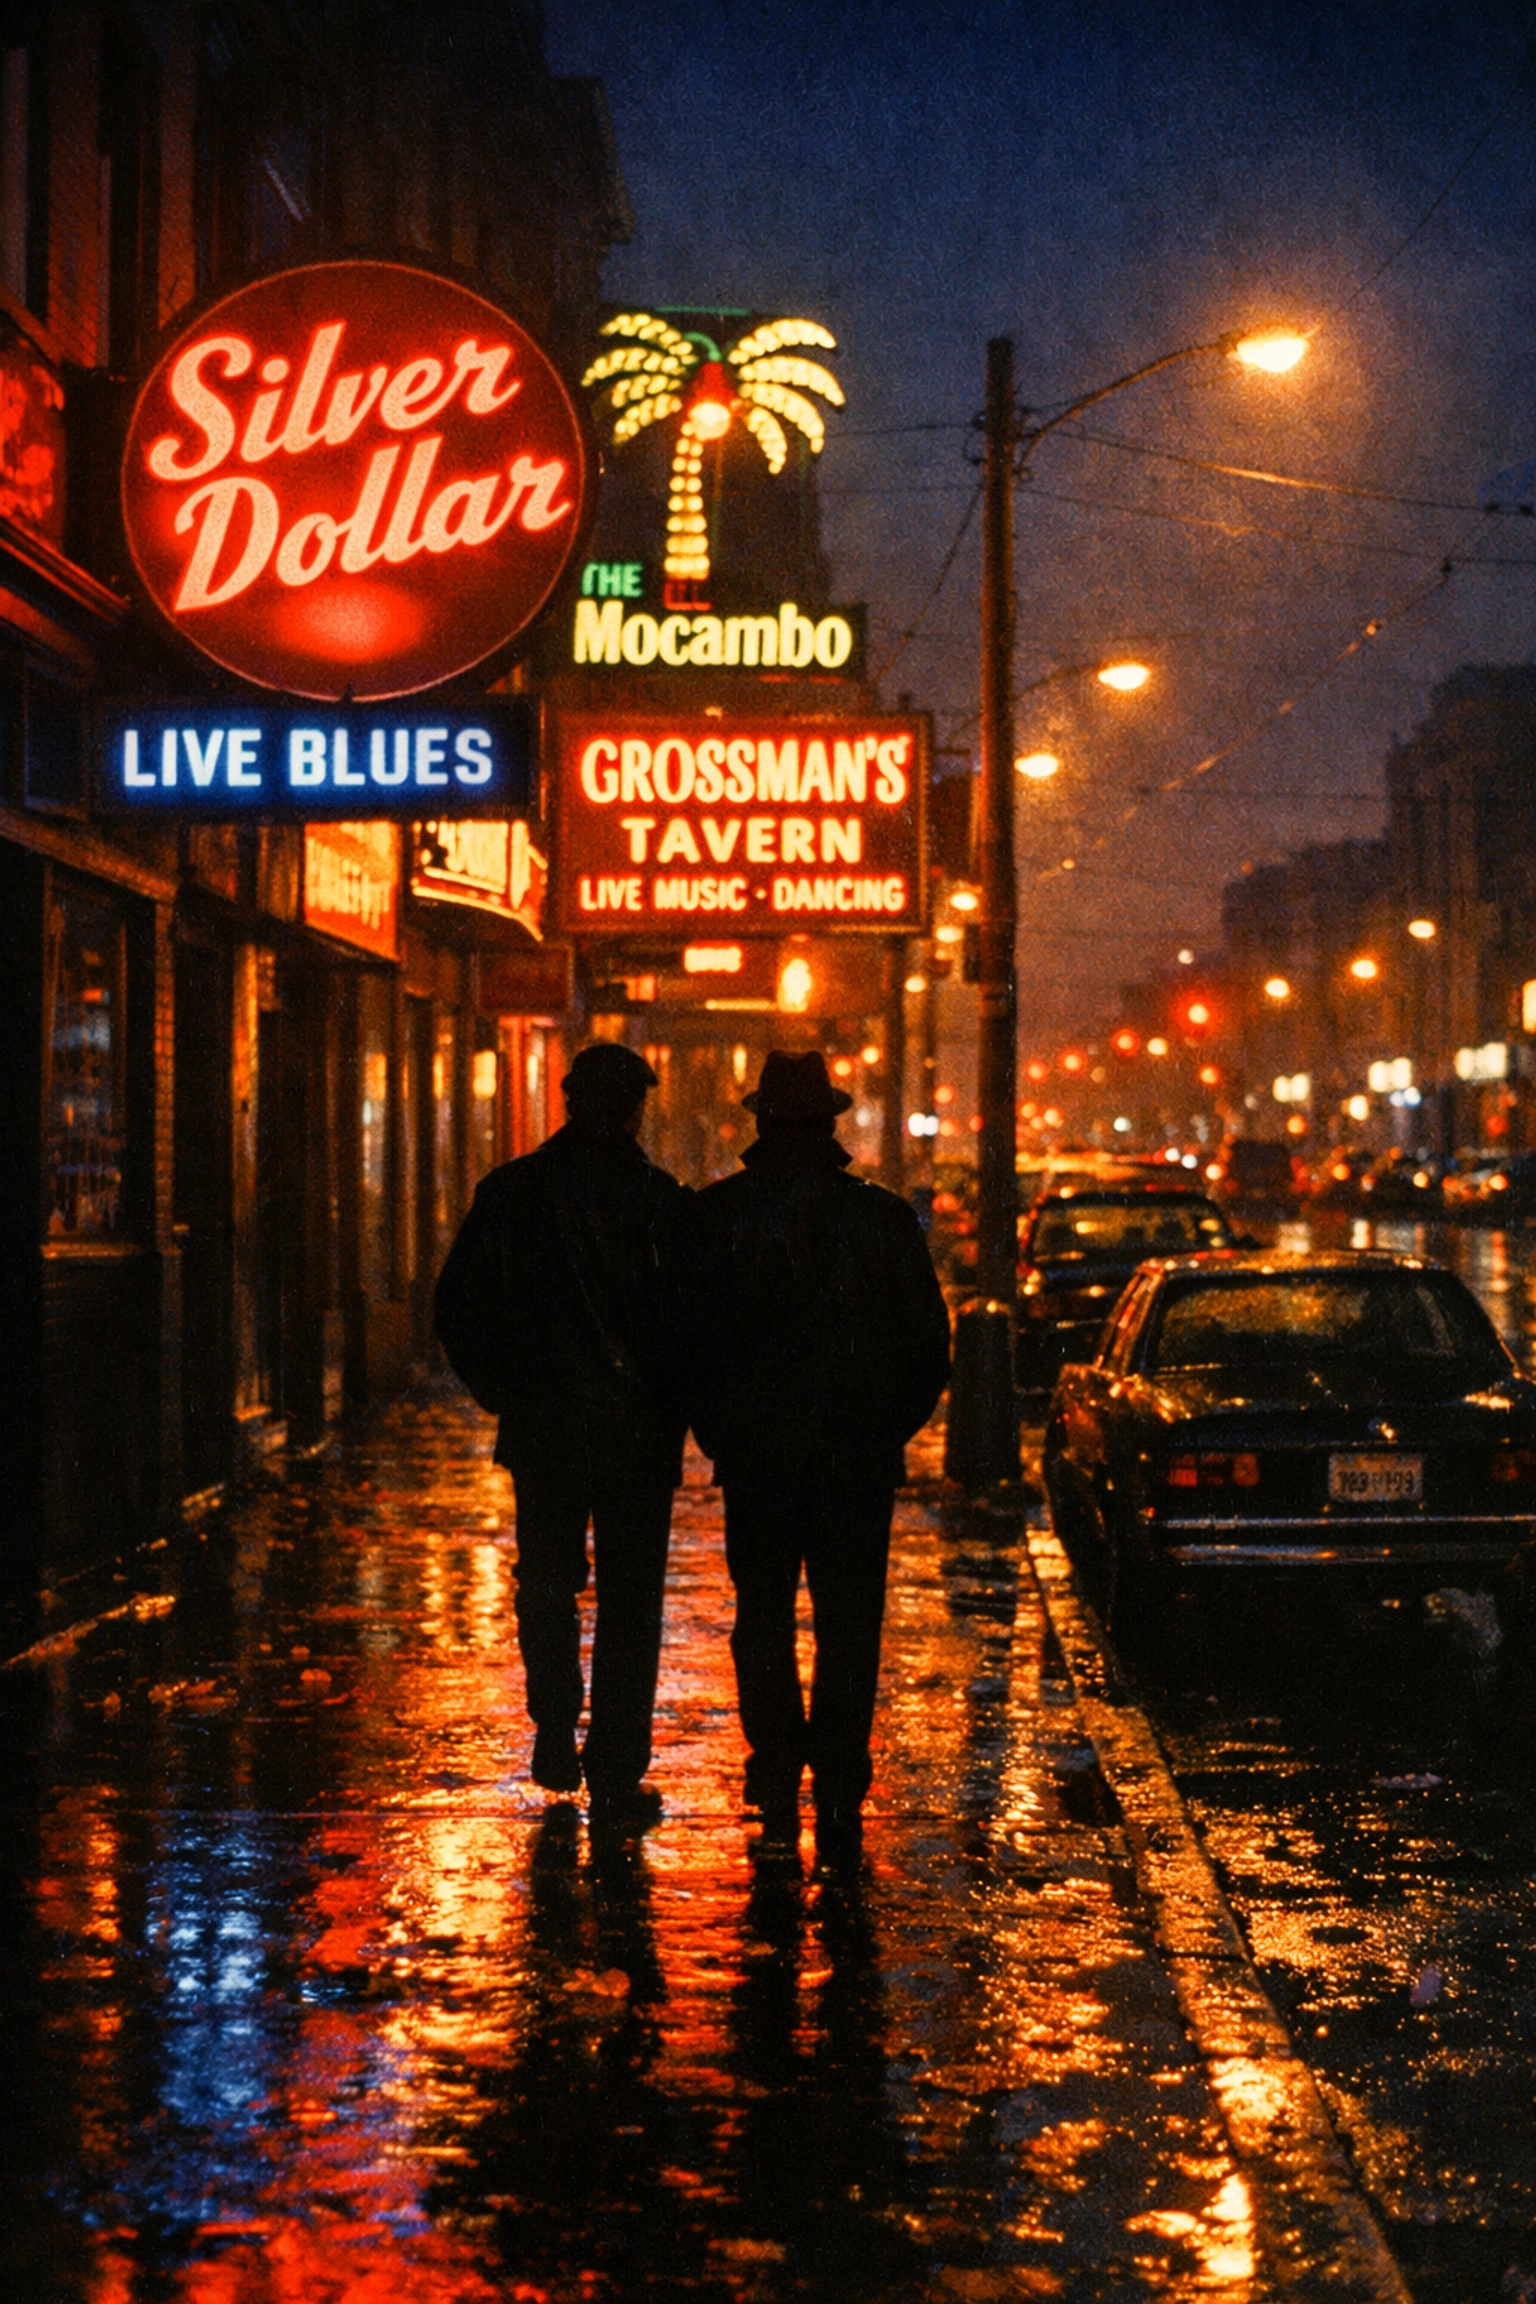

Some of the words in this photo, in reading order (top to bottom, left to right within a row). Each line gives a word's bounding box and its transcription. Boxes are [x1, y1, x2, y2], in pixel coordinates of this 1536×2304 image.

[149, 321, 519, 481] Silver
[174, 435, 570, 613] Dollar
[582, 563, 642, 597] THE
[574, 600, 852, 667] Mocambo
[123, 728, 261, 787] LIVE
[289, 728, 493, 786] BLUES
[581, 736, 911, 803] GROSSMAN'S
[621, 817, 861, 863] TAVERN
[580, 878, 642, 911] LIVE
[655, 878, 747, 911] MUSIC
[772, 878, 905, 911] DANCING
